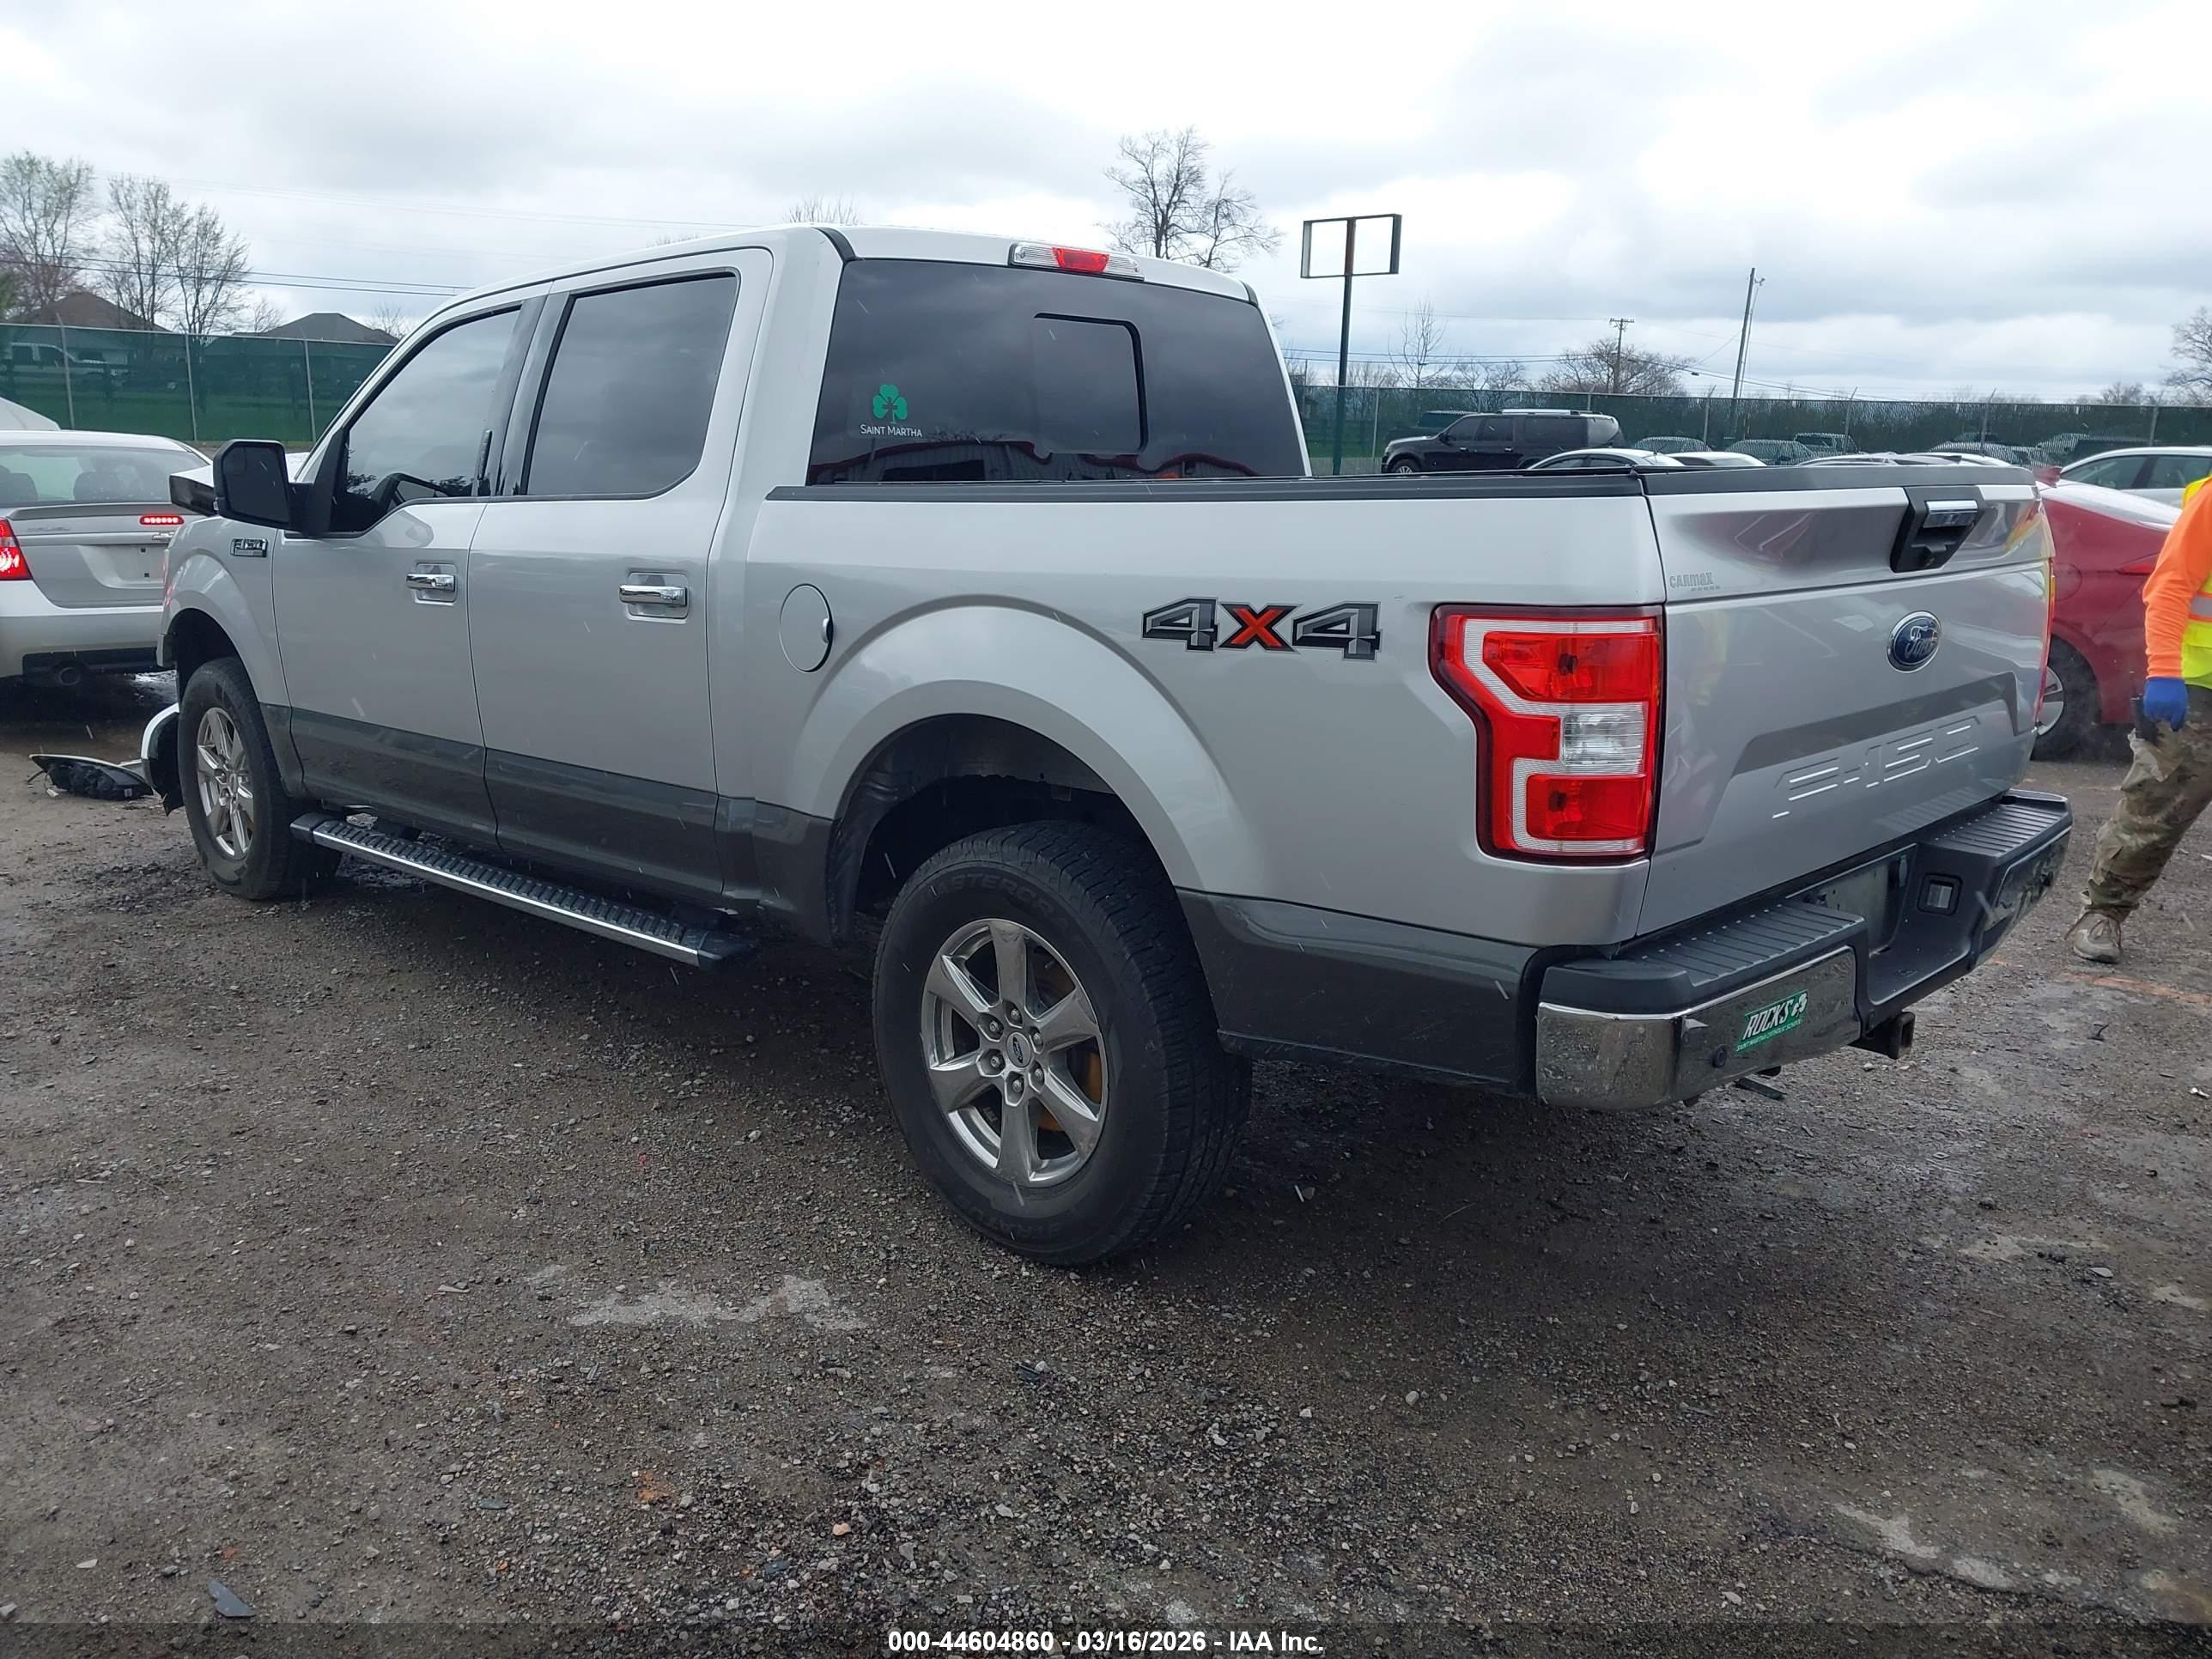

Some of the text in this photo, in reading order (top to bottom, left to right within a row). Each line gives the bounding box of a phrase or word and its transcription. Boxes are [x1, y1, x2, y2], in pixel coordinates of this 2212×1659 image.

[860, 424, 922, 437] SAINT MARTHA
[1742, 999, 1795, 1040] ROCKS
